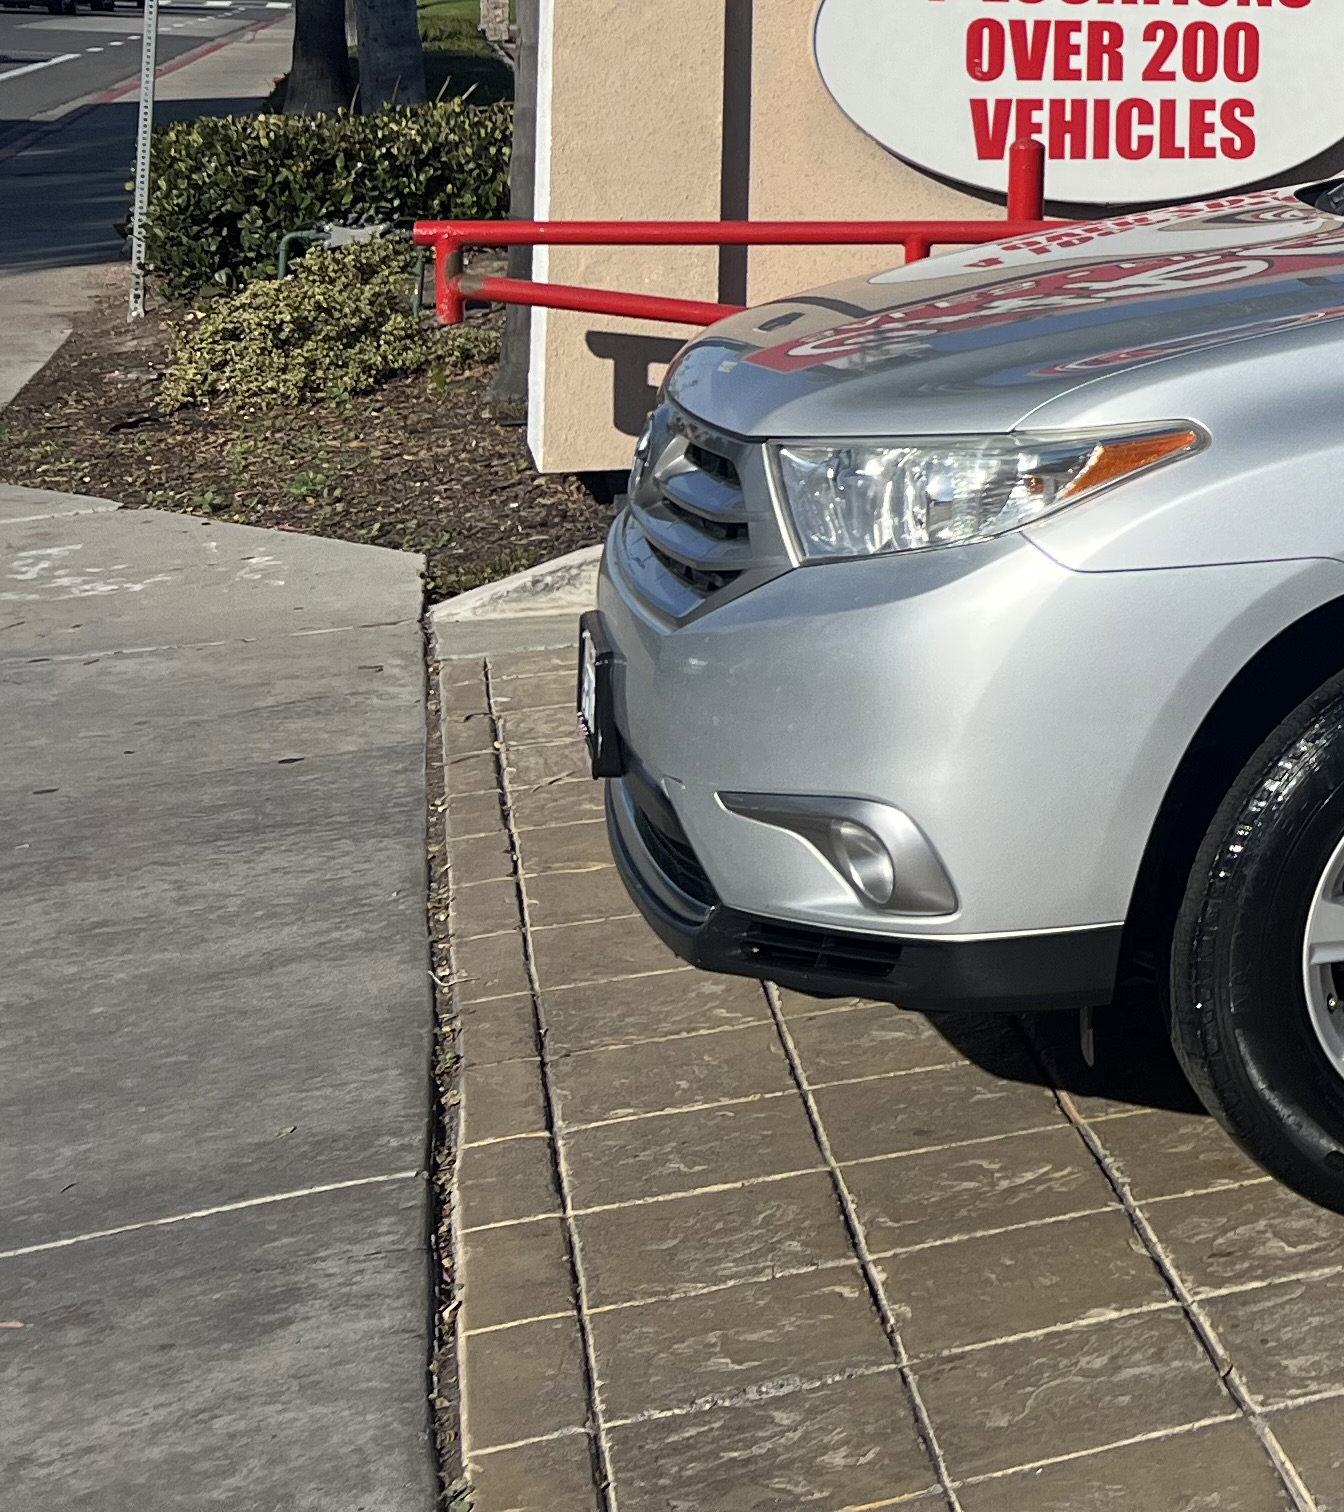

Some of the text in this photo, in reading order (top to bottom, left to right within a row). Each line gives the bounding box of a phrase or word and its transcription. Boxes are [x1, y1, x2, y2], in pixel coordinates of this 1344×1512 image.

[966, 17, 1260, 83] OVER 200
[969, 97, 1256, 161] VEHICLES
